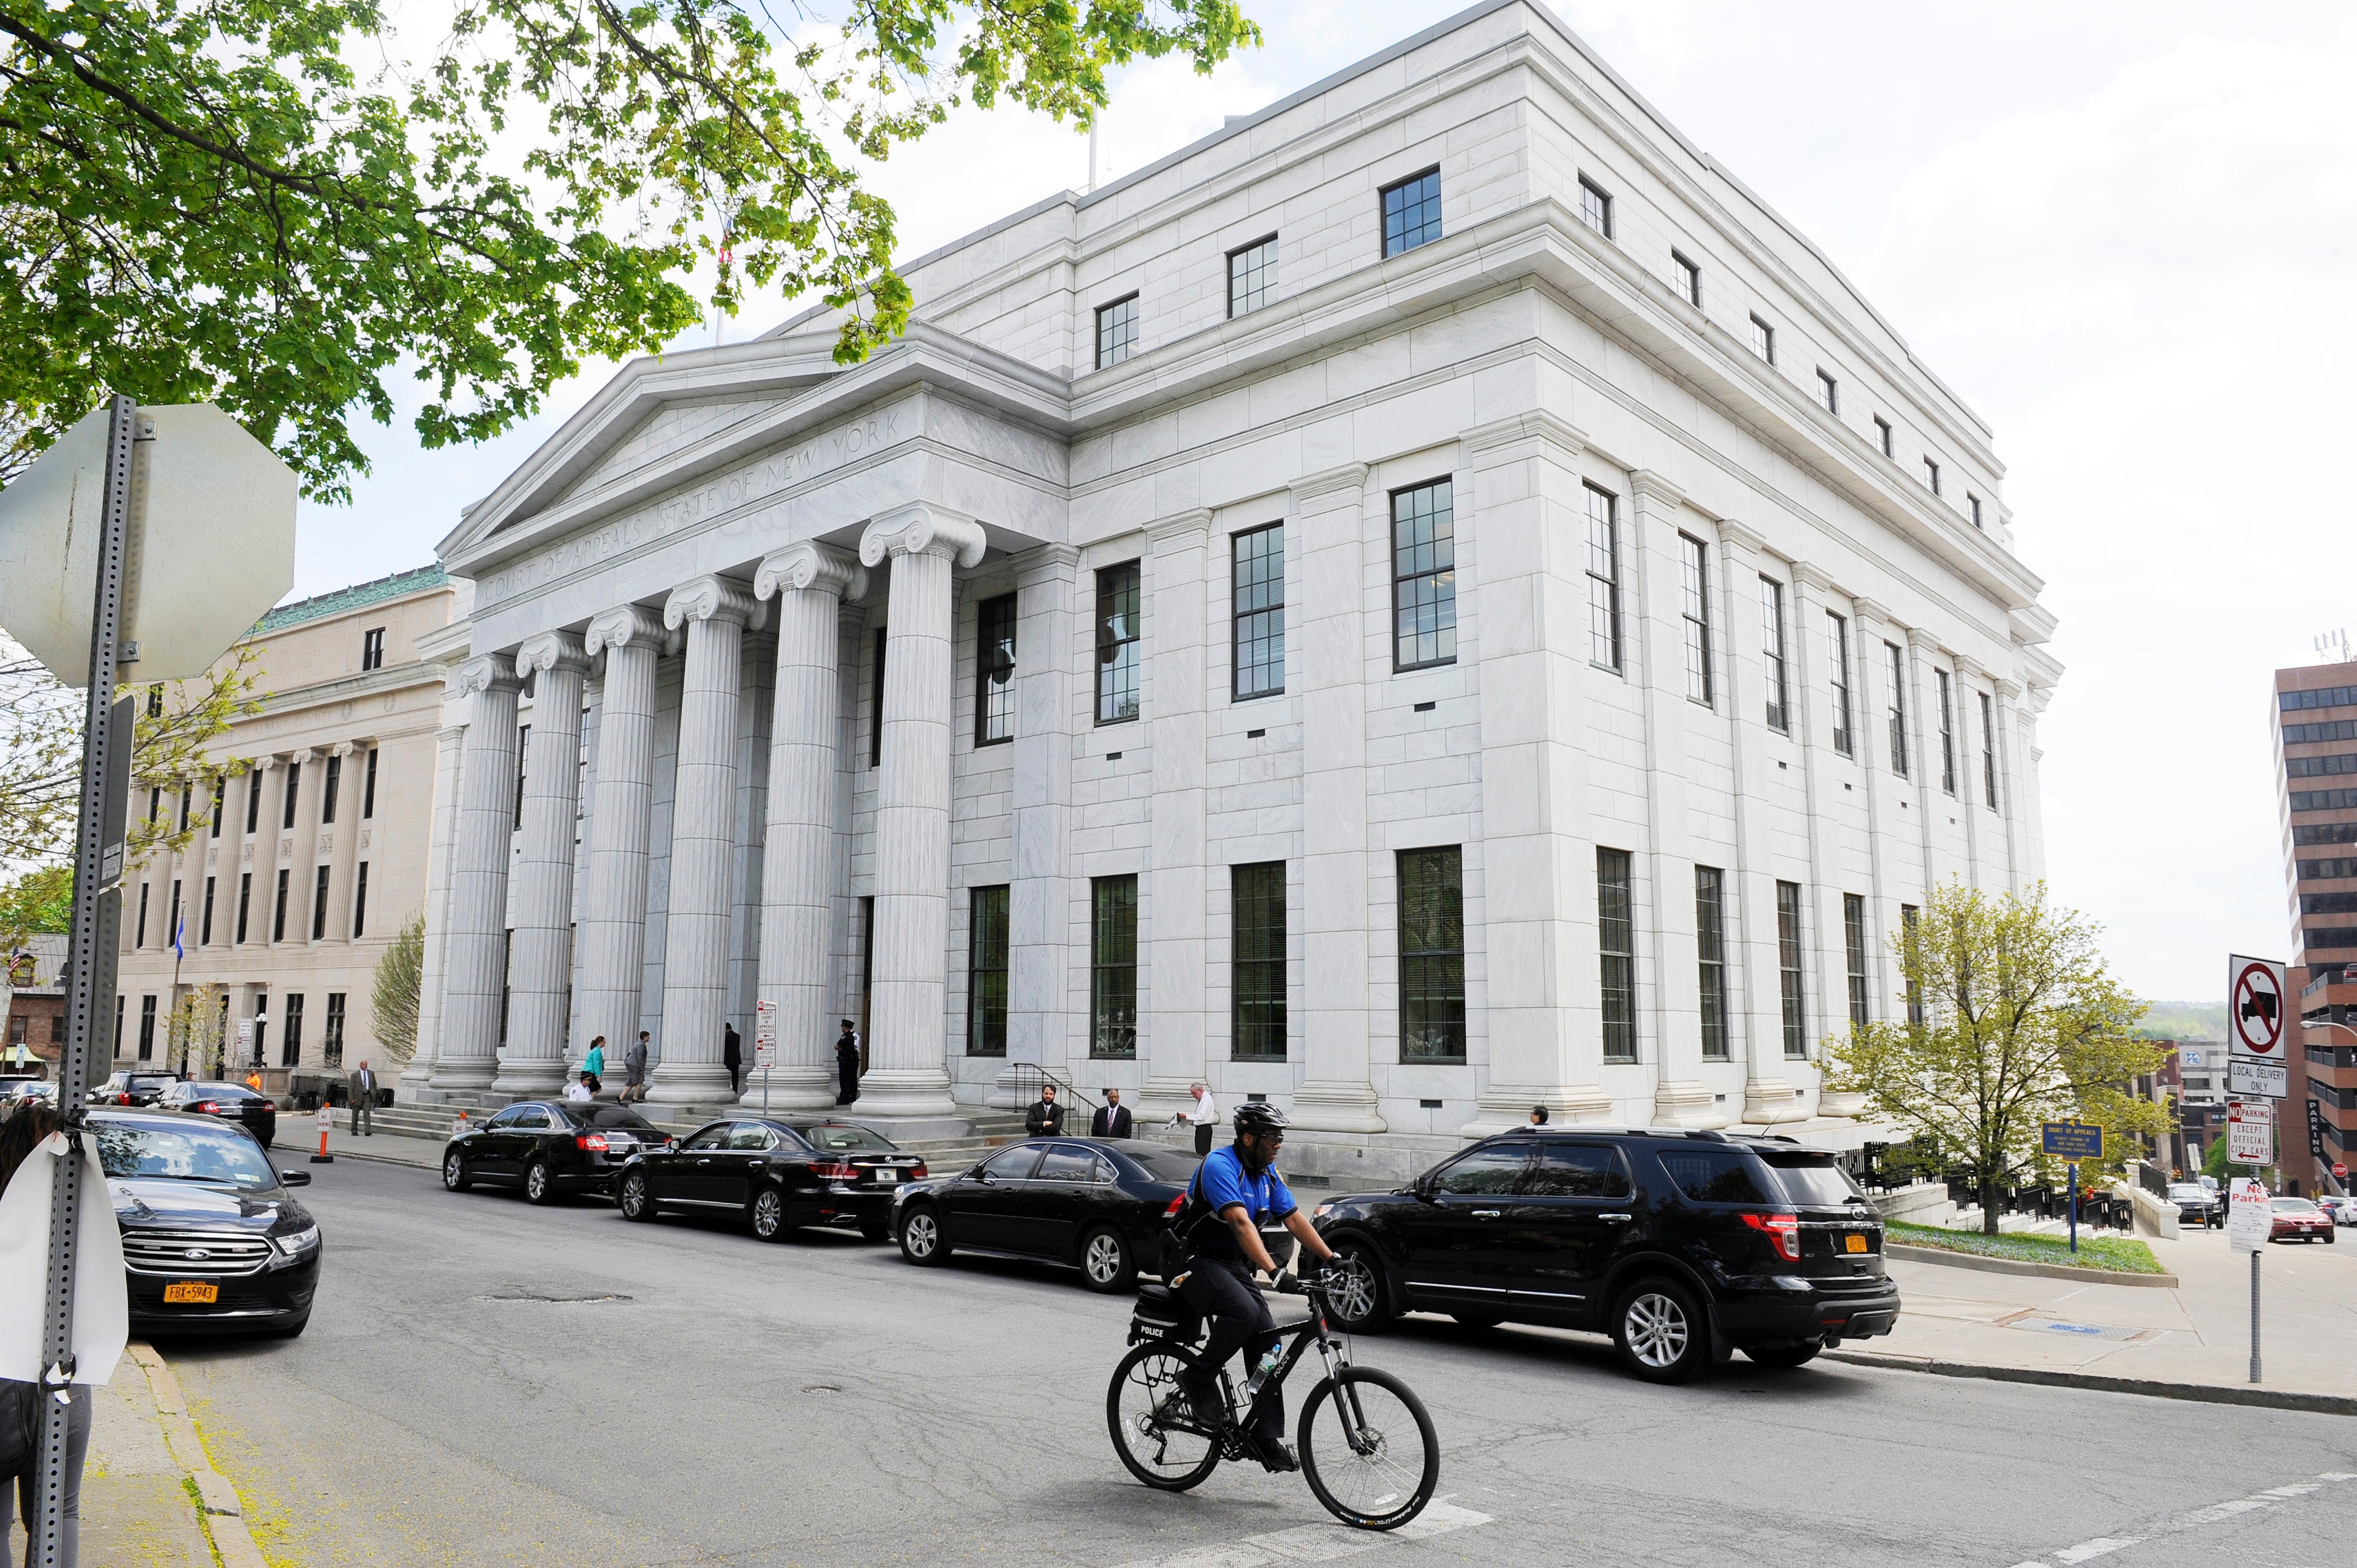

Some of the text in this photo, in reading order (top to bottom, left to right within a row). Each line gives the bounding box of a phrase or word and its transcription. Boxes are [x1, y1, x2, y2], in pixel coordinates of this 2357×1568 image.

[485, 410, 899, 601] COURT OF APPEALS STATE OF NEW YORK
[2233, 1066, 2284, 1080] LOCAL DELIVERY
[2251, 1081, 2268, 1091] ONLY
[2230, 1106, 2268, 1118] NO PARKING
[2237, 1125, 2262, 1134] EXCEPT
[2309, 1102, 2320, 1153] PARKING
[2234, 1135, 2266, 1145] OFFICIAL
[2231, 1145, 2268, 1156] CITY CARS
[2247, 1185, 2262, 1193] No
[1141, 1325, 1164, 1338] POLICE
[1274, 1353, 1290, 1378] POLICE
[1391, 1505, 1412, 1522] Rubber
